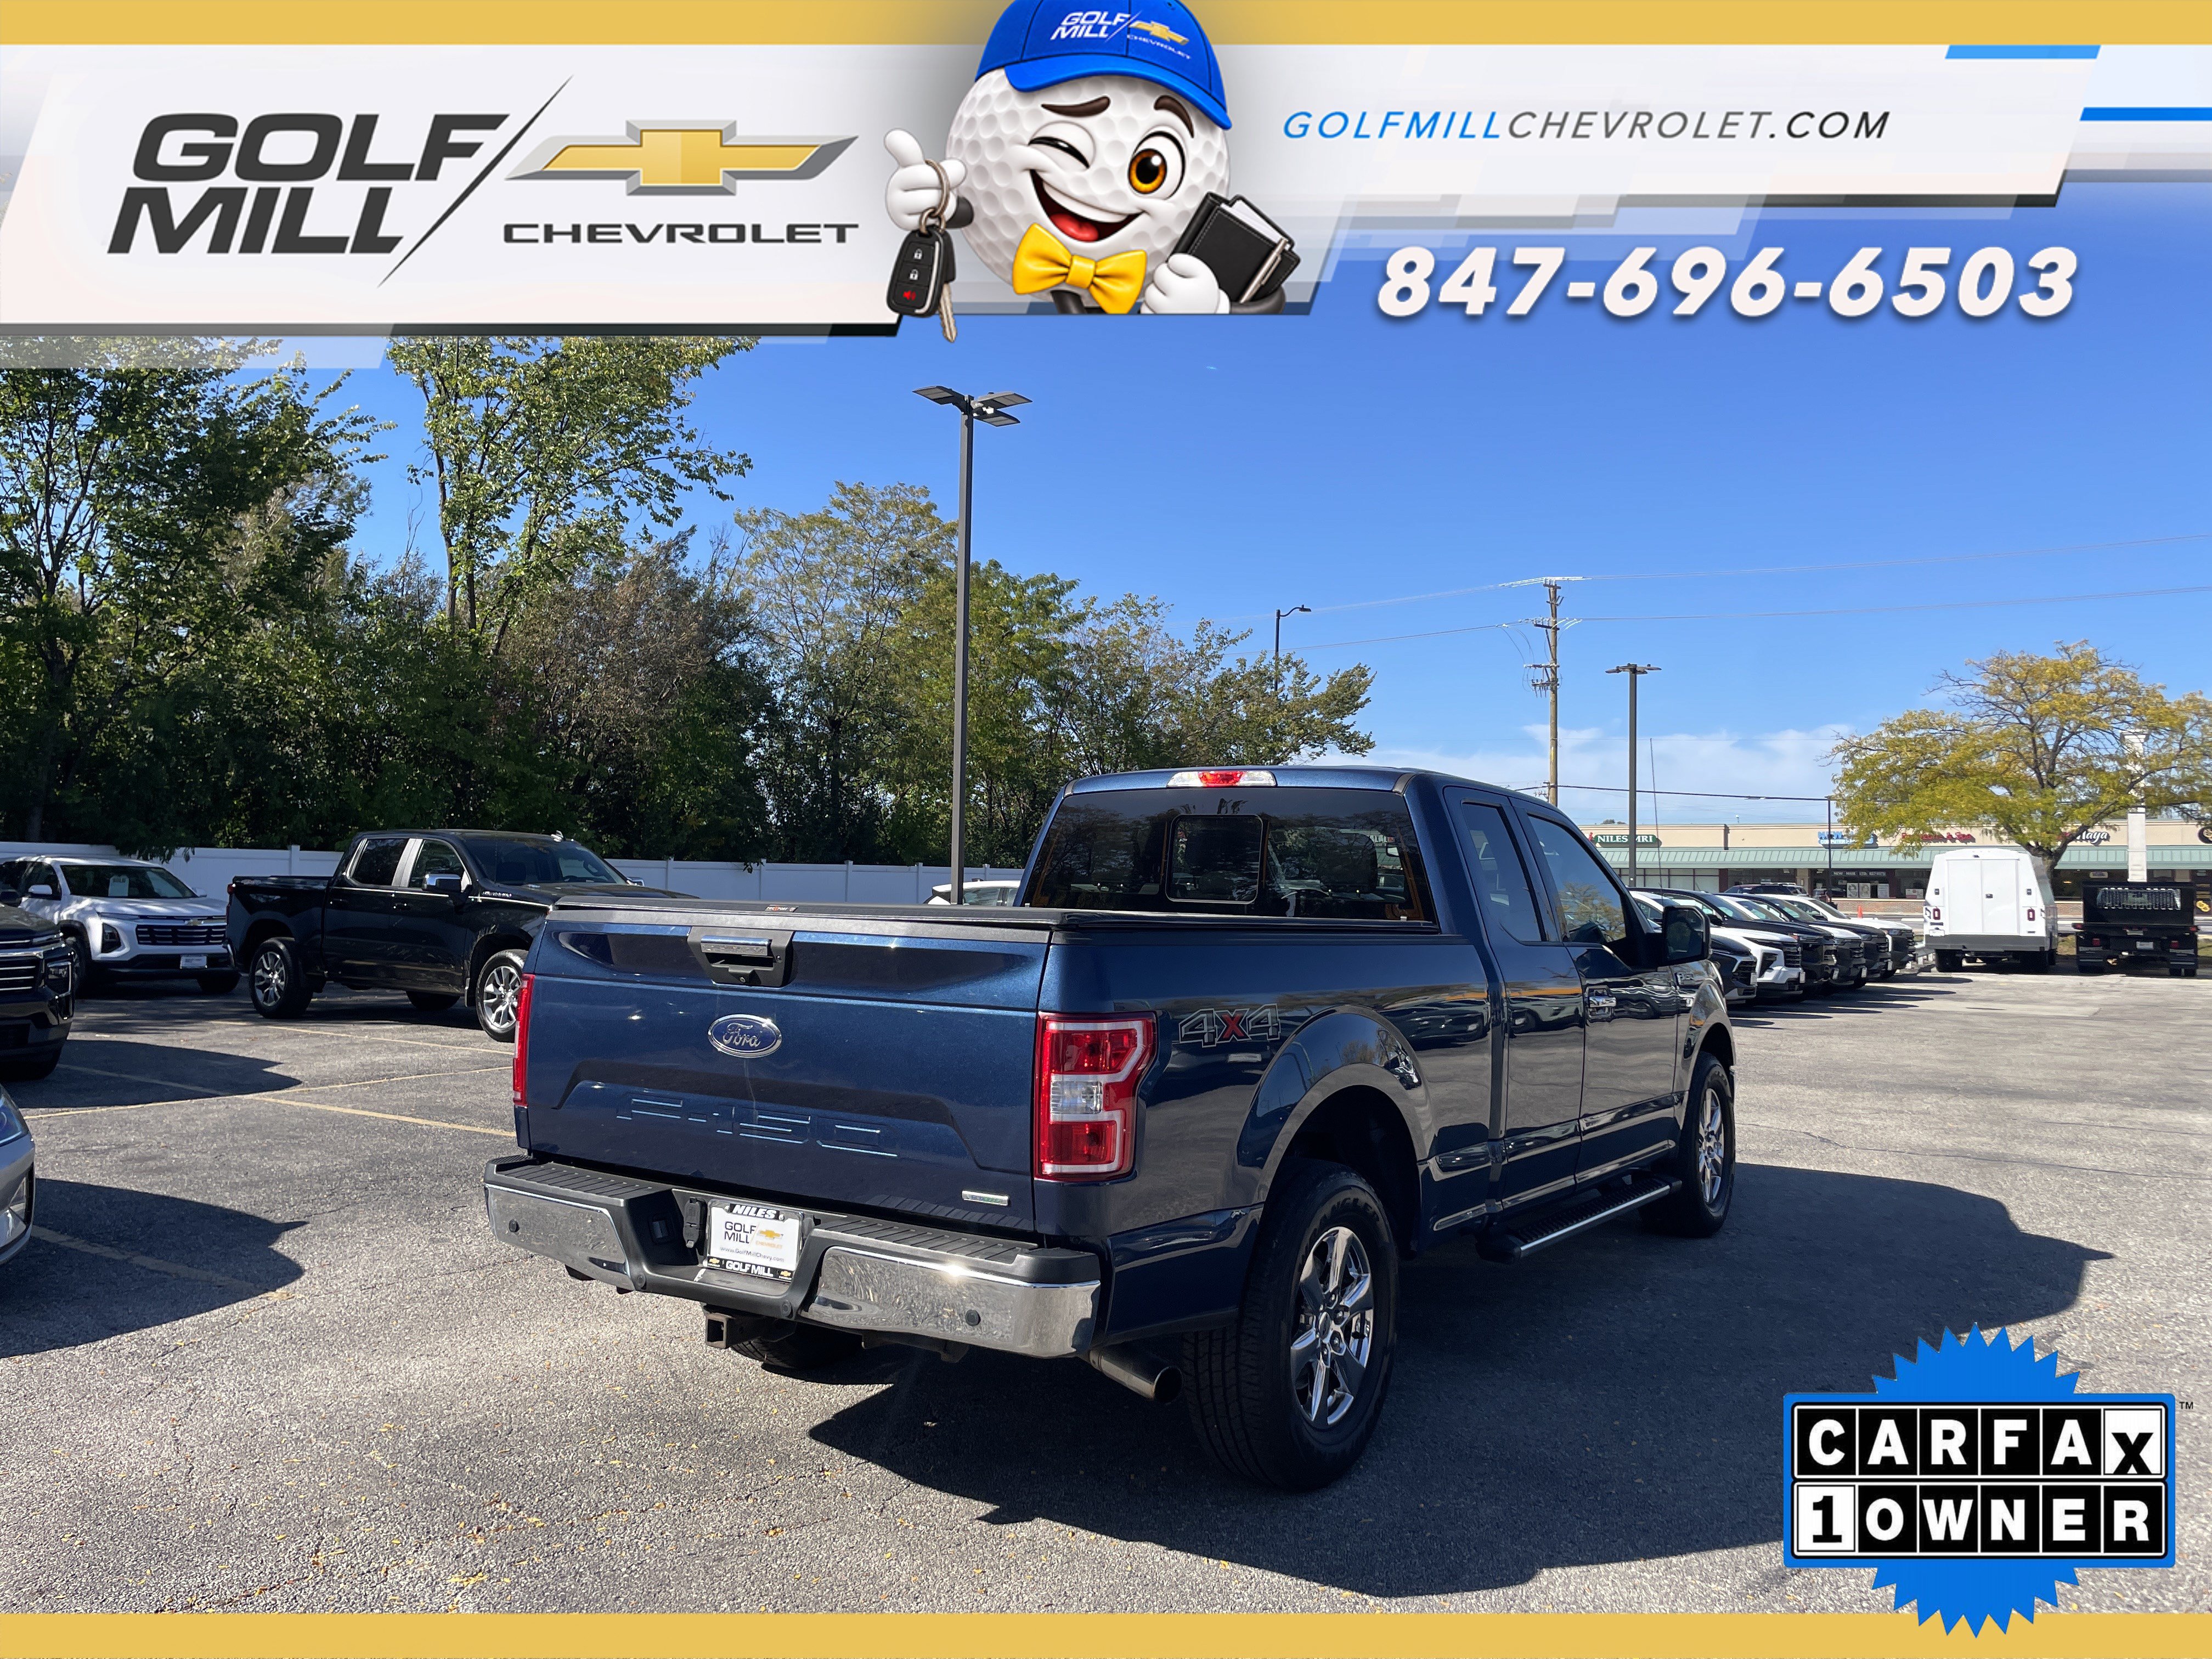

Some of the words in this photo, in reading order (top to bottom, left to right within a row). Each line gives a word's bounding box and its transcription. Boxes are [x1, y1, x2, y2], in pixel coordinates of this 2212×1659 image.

[723, 1022, 762, 1048] Ford
[732, 1204, 776, 1219] NILES
[725, 1221, 757, 1234] GOLF
[724, 1231, 749, 1244] MILL
[725, 1260, 751, 1273] GOLF
[751, 1265, 774, 1277] MILL
